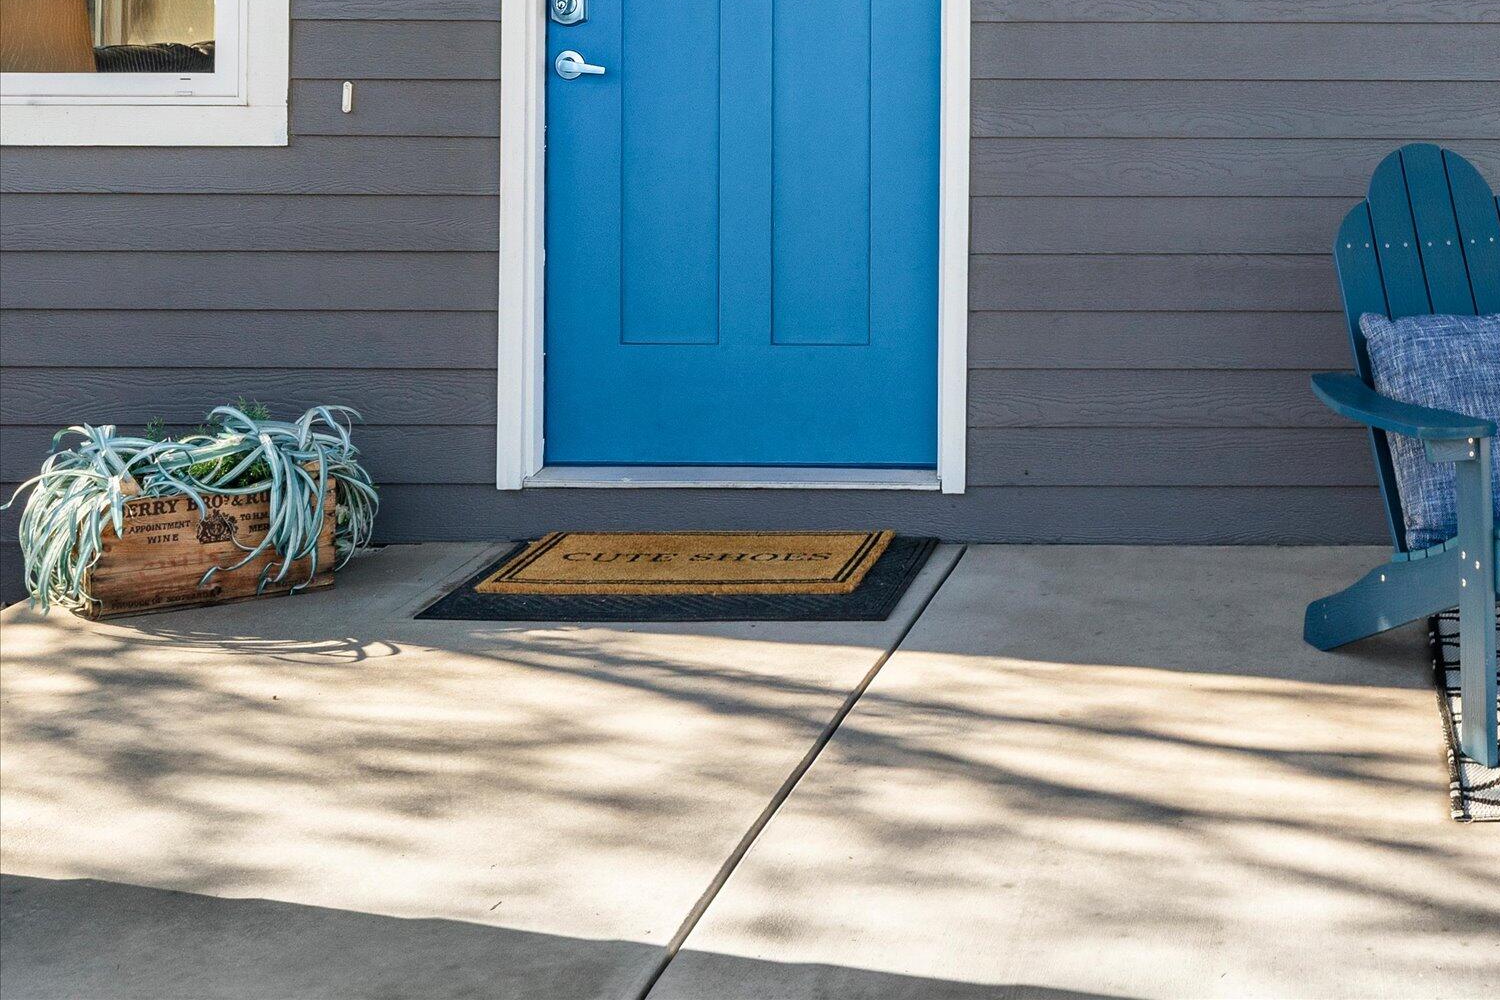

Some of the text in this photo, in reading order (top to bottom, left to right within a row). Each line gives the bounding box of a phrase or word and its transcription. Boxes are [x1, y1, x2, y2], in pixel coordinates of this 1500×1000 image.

[121, 499, 180, 519] ERRY
[128, 519, 191, 535] APPOINTMENT
[146, 533, 179, 545] WINE
[563, 552, 832, 563] CUTE SHOES
